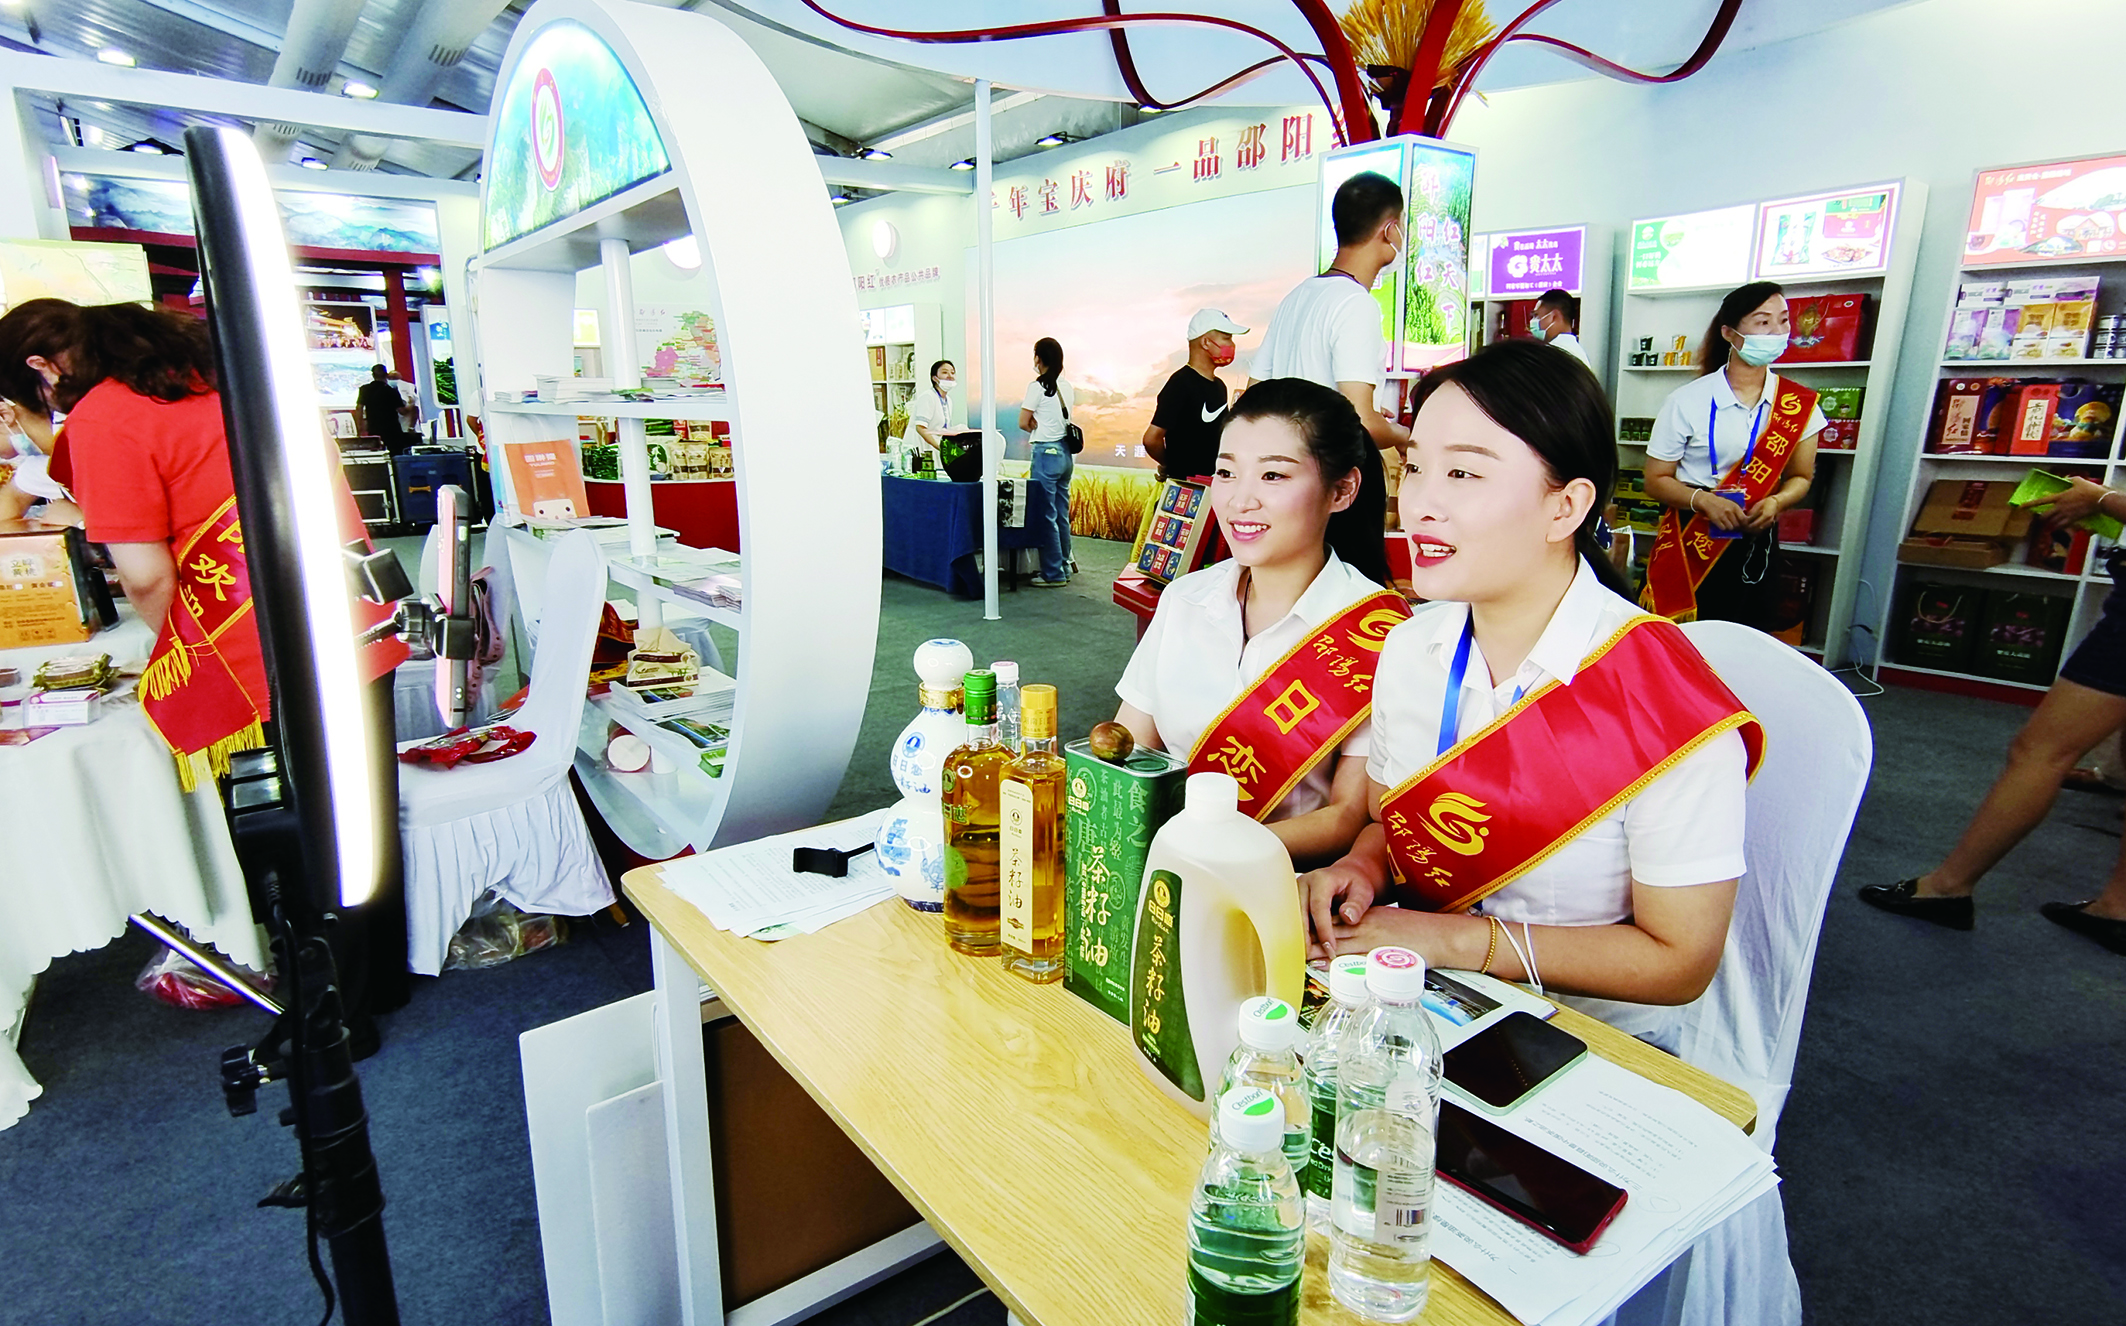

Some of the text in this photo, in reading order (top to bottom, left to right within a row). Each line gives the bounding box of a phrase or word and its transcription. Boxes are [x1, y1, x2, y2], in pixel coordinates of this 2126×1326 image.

[993, 159, 1130, 220] 年宝庆府
[1529, 252, 1564, 274] 贵太太
[893, 753, 923, 777] 日日恋
[1126, 779, 1149, 849] 食之
[1008, 847, 1024, 909] 茶籽油
[1085, 845, 1112, 968] 茶籽油
[1143, 934, 1167, 1035] 茶籽油
